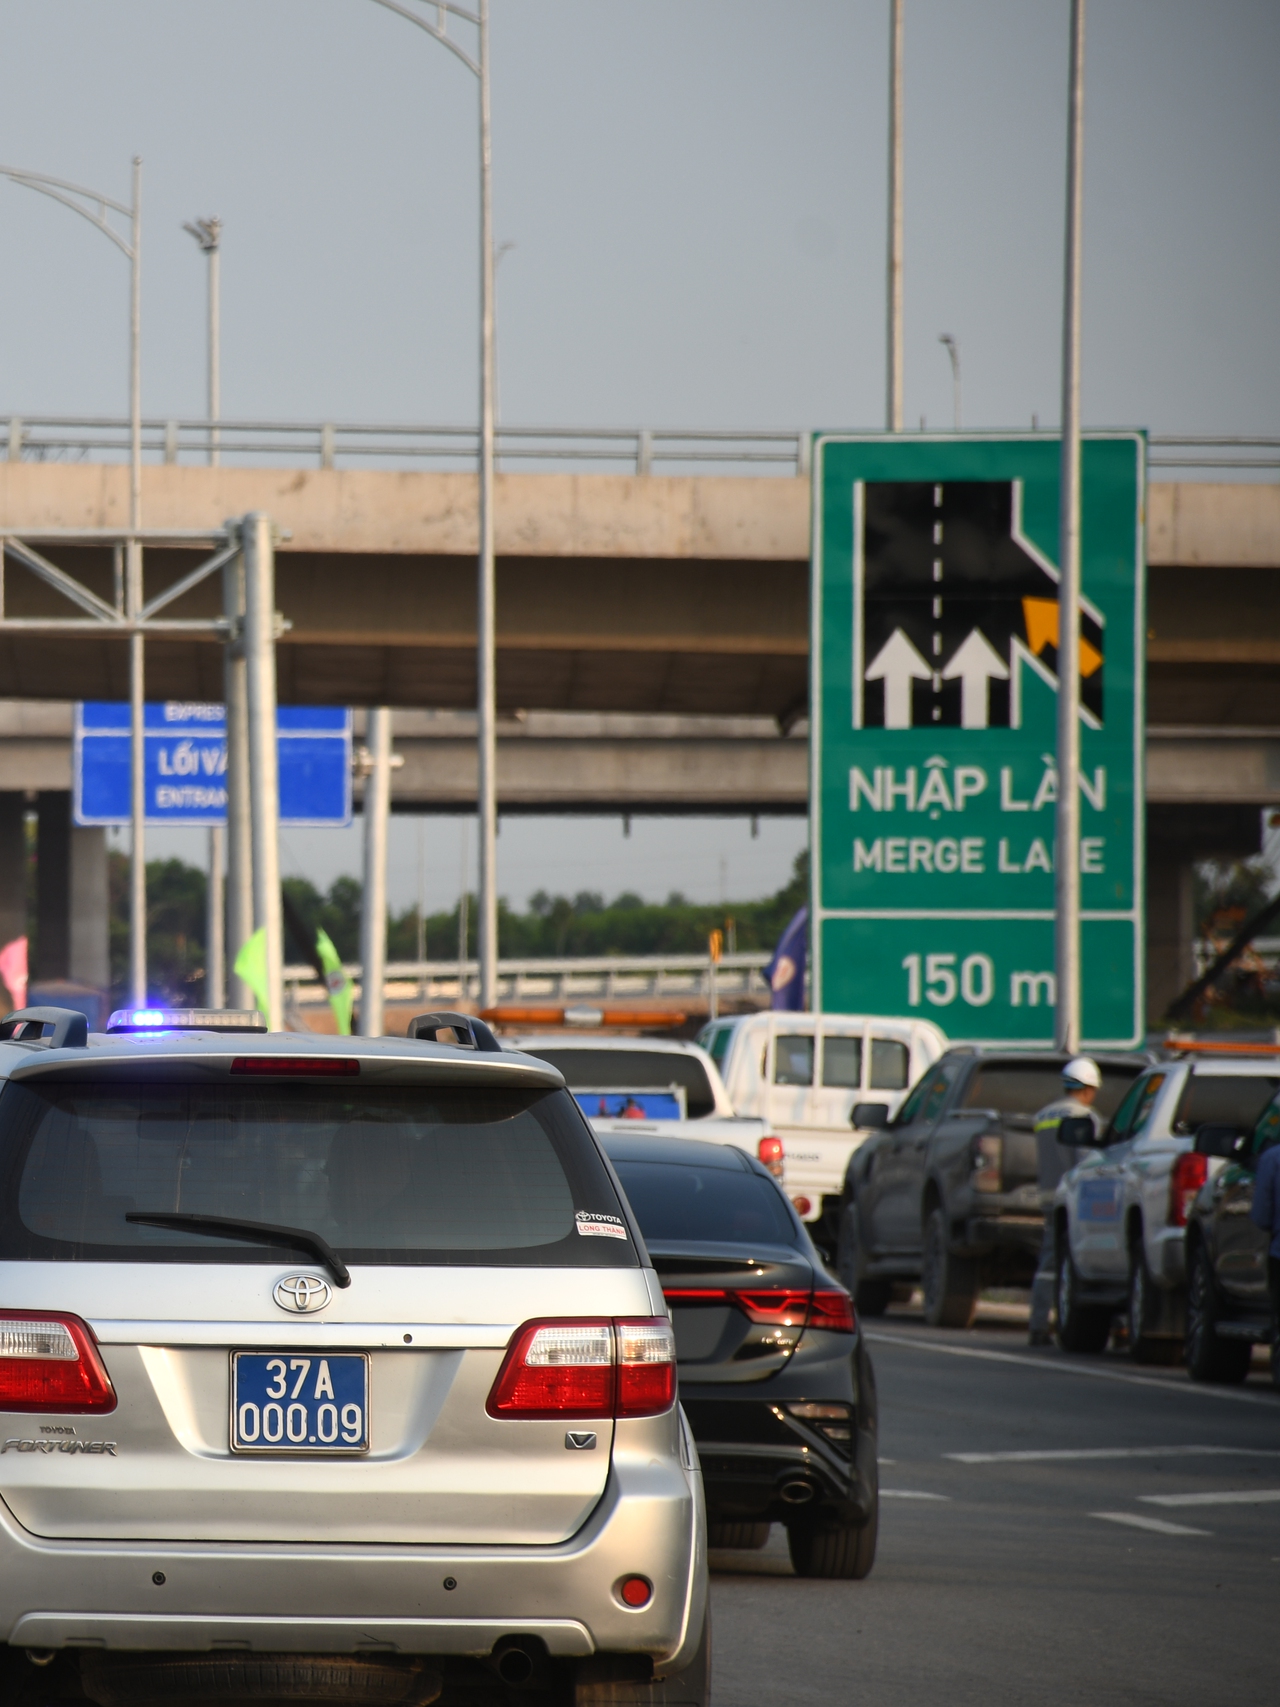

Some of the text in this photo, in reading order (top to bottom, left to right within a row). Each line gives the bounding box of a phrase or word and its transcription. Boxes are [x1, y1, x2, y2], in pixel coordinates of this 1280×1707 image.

[159, 740, 228, 776] LỐI VÀ
[848, 752, 1106, 820] NHẬP LÀN
[852, 837, 1106, 874] MERGE LAE
[902, 953, 1057, 1007] 150 m
[590, 1213, 622, 1225] TOYOTA
[266, 1359, 335, 1399] 37A
[39, 1426, 77, 1435] TOYOTA
[239, 1402, 362, 1443] 000.09
[1, 1438, 118, 1457] FORTUNER
